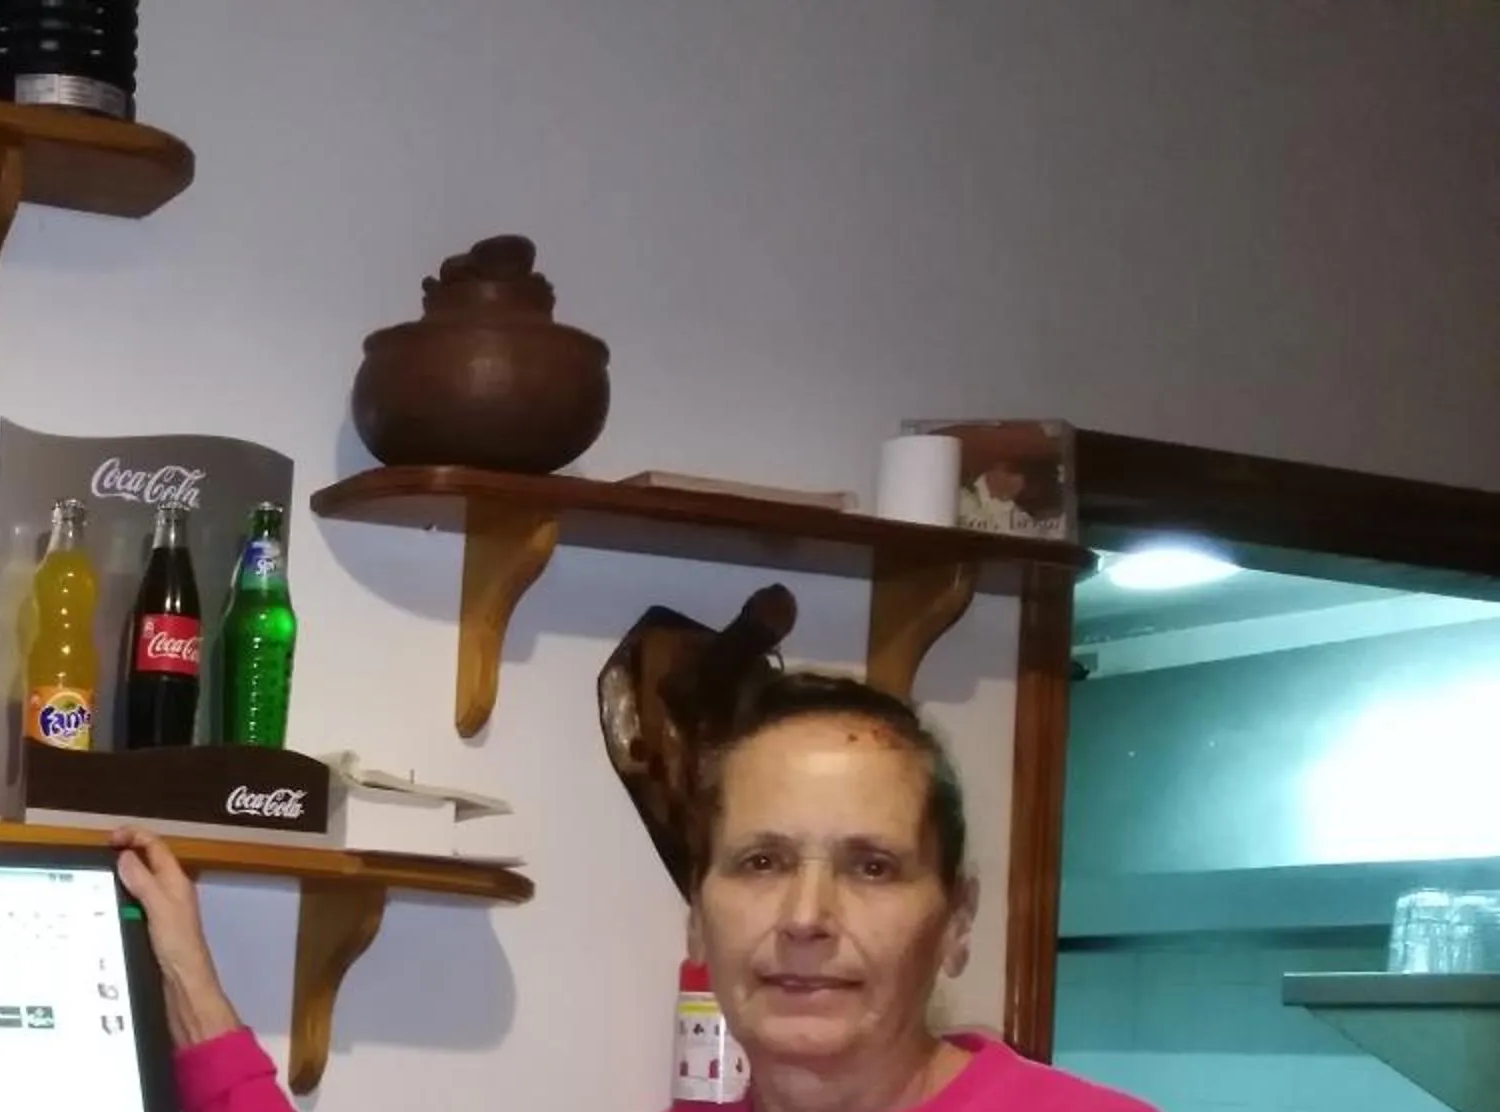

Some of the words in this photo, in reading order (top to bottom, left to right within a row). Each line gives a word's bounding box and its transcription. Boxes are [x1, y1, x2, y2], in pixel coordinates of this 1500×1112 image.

[91, 457, 206, 508] Coca-Cola
[39, 704, 92, 738] Fant
[226, 785, 308, 819] Coca-Cola
